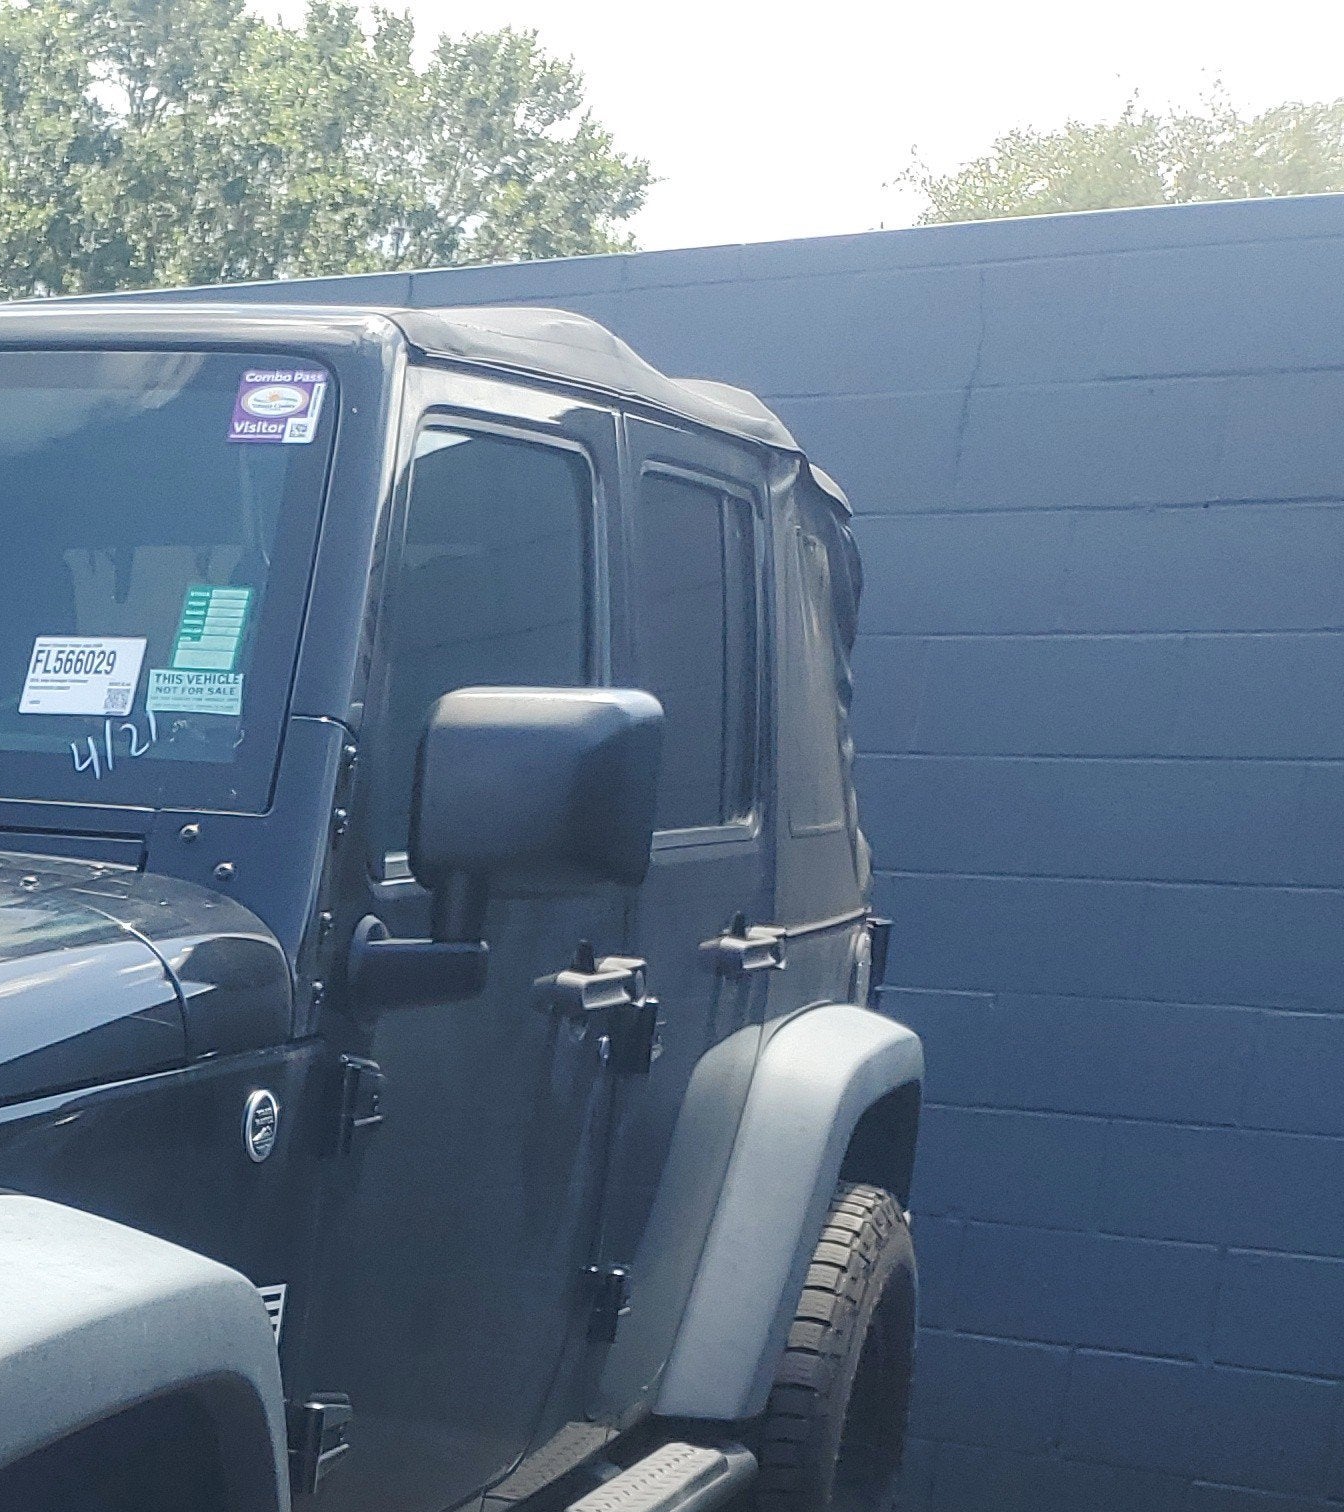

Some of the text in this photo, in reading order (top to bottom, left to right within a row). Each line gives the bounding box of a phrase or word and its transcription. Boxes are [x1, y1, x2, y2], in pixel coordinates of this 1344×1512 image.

[245, 370, 324, 382] Combo Pass
[233, 421, 285, 434] Visitor
[32, 649, 117, 675] FL566029
[155, 673, 240, 685] THIS VEHICLE
[155, 686, 236, 696] NOT FOR SALE
